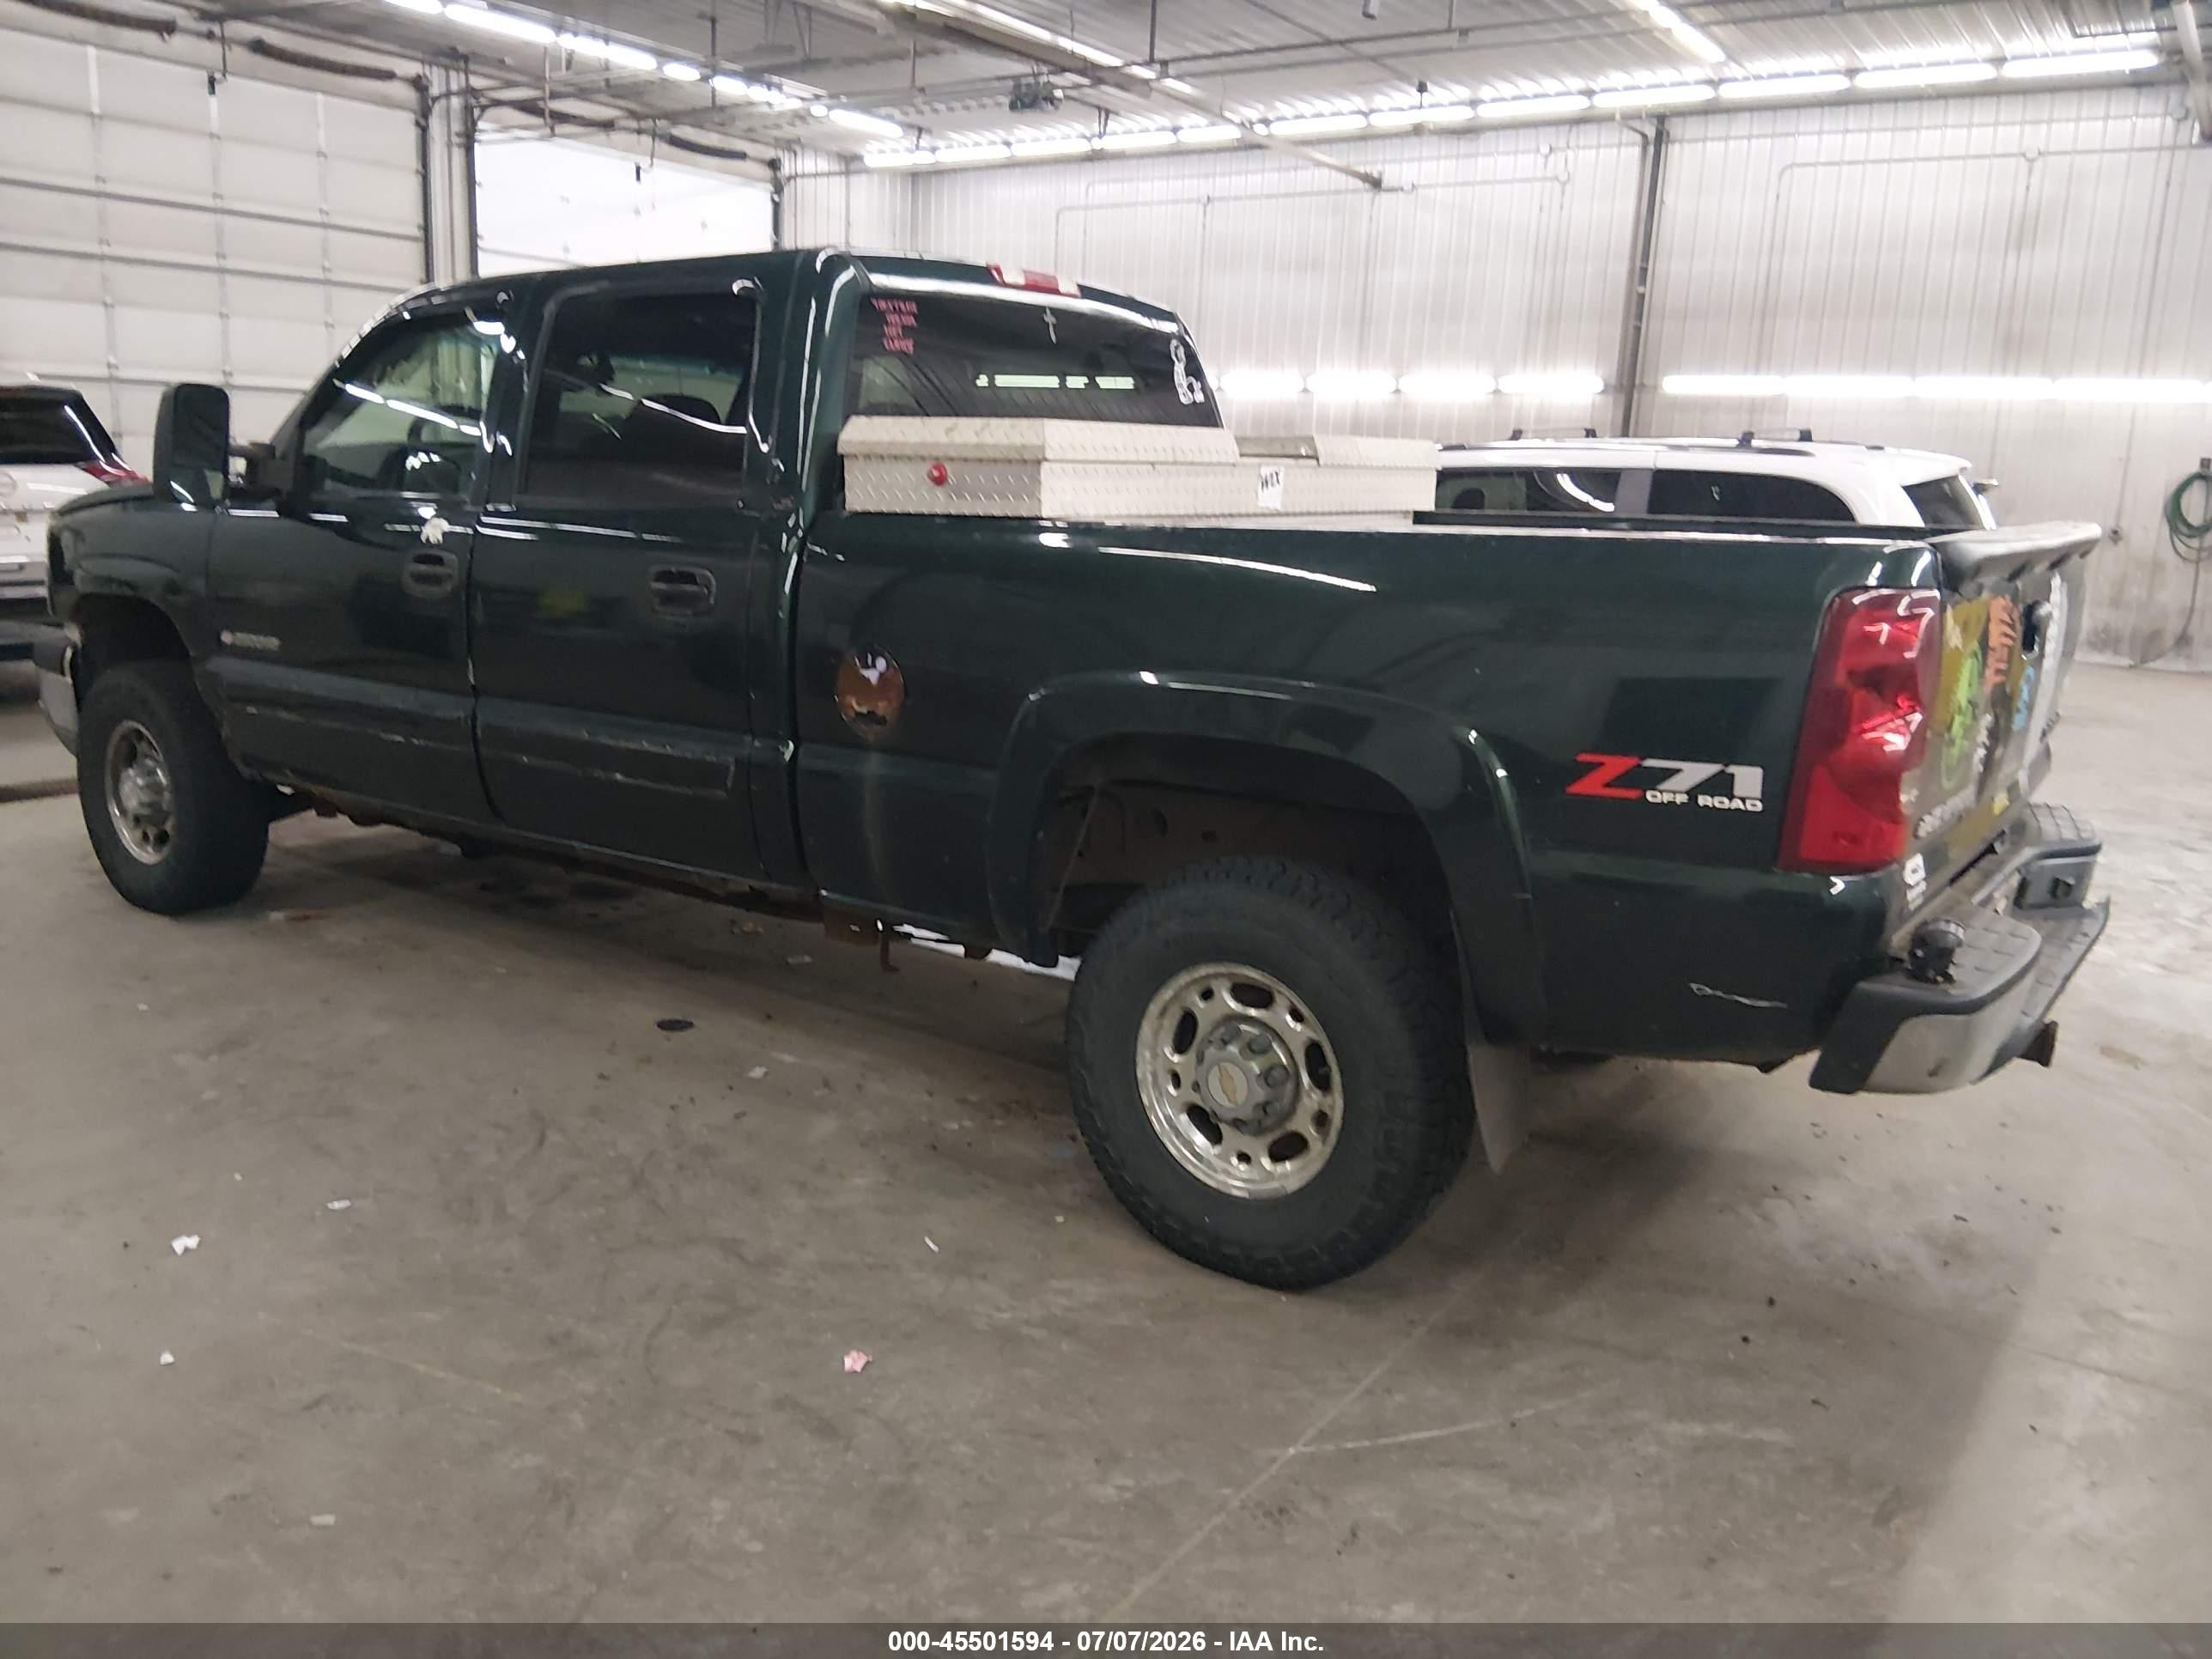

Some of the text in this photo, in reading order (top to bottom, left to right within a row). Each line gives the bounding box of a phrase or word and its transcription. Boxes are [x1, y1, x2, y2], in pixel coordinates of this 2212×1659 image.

[1565, 752, 1764, 799] Z71
[1645, 789, 1764, 812] OFF ROAD
